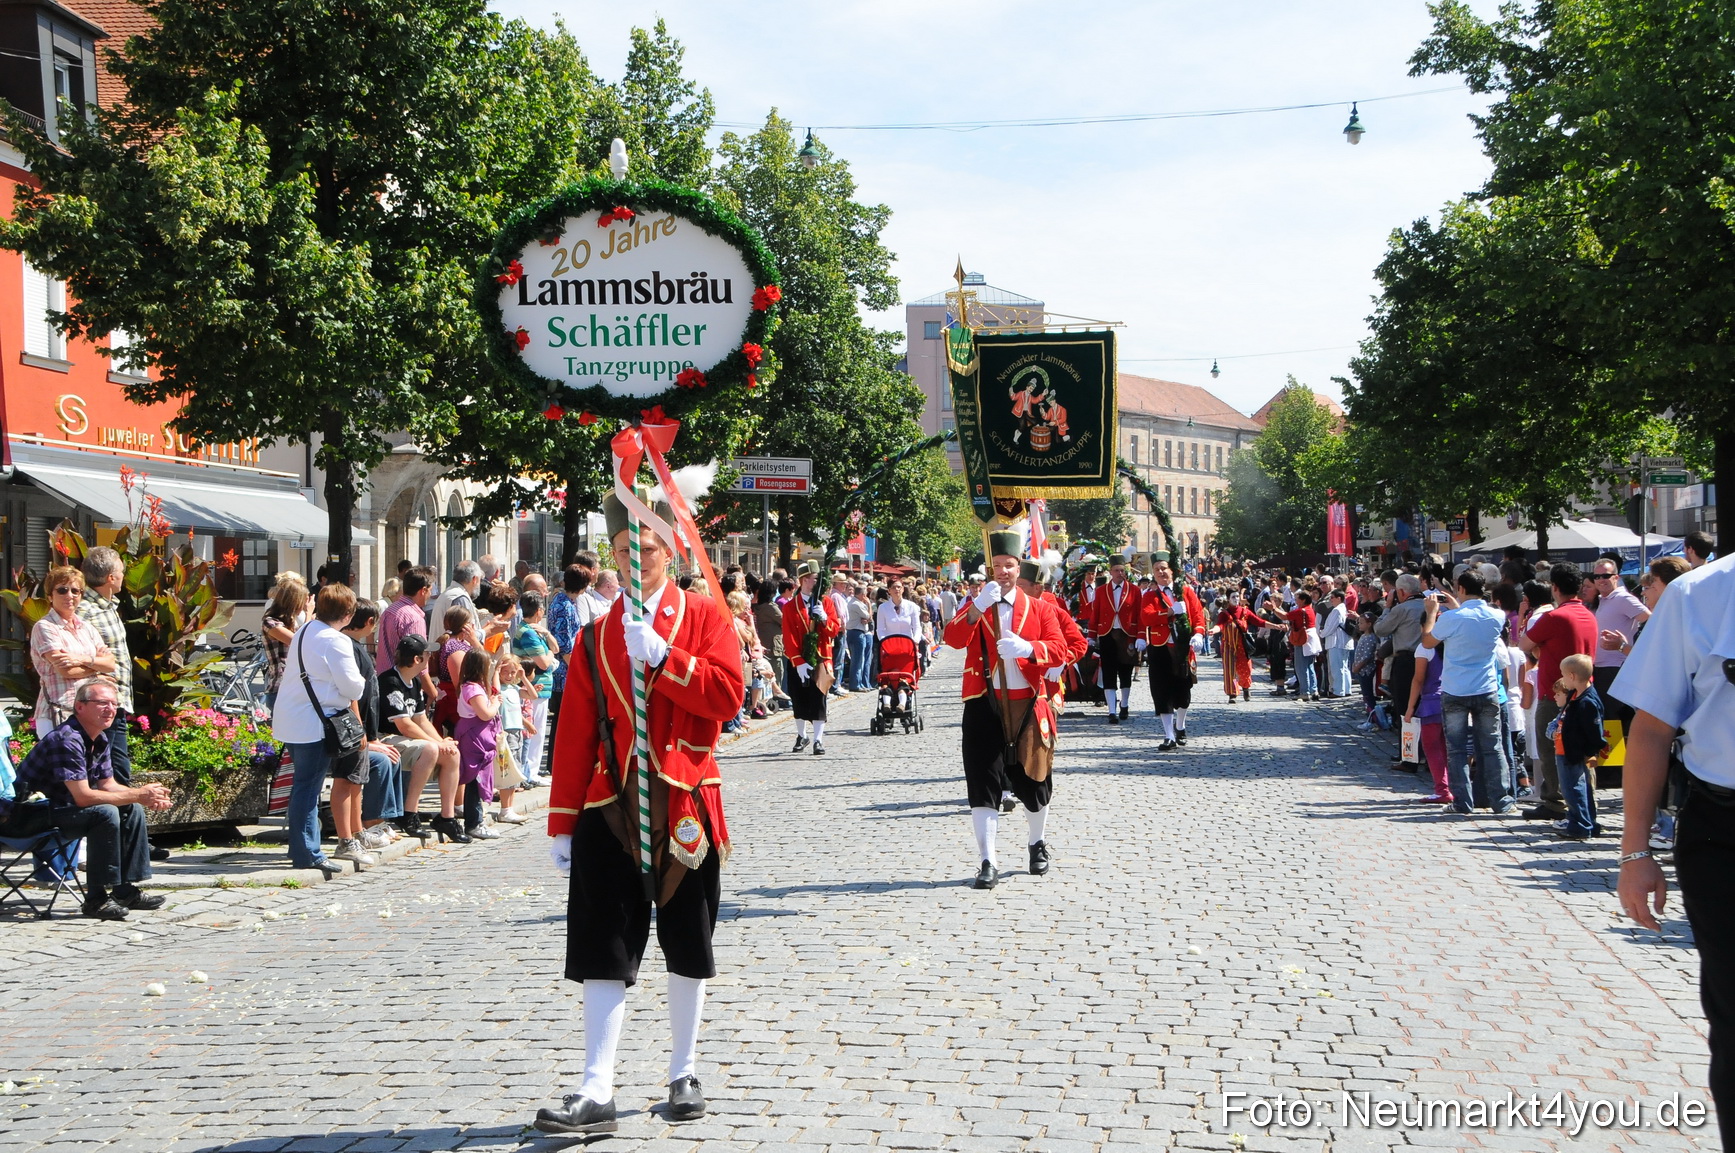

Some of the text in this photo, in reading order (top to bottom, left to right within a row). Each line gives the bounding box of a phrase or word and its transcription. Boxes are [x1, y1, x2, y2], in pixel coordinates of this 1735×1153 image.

[551, 214, 678, 278] 20 Jahre
[517, 271, 733, 306] Lammsbräu
[547, 313, 707, 348] Schäffler
[563, 356, 695, 382] Tanzgruppe
[996, 353, 1038, 383] Neumarkter
[740, 461, 797, 474] Parkleitsystem
[1078, 461, 1093, 469] 1990
[1649, 459, 1682, 467] Viehmarkt
[759, 478, 797, 489] Rosengasse
